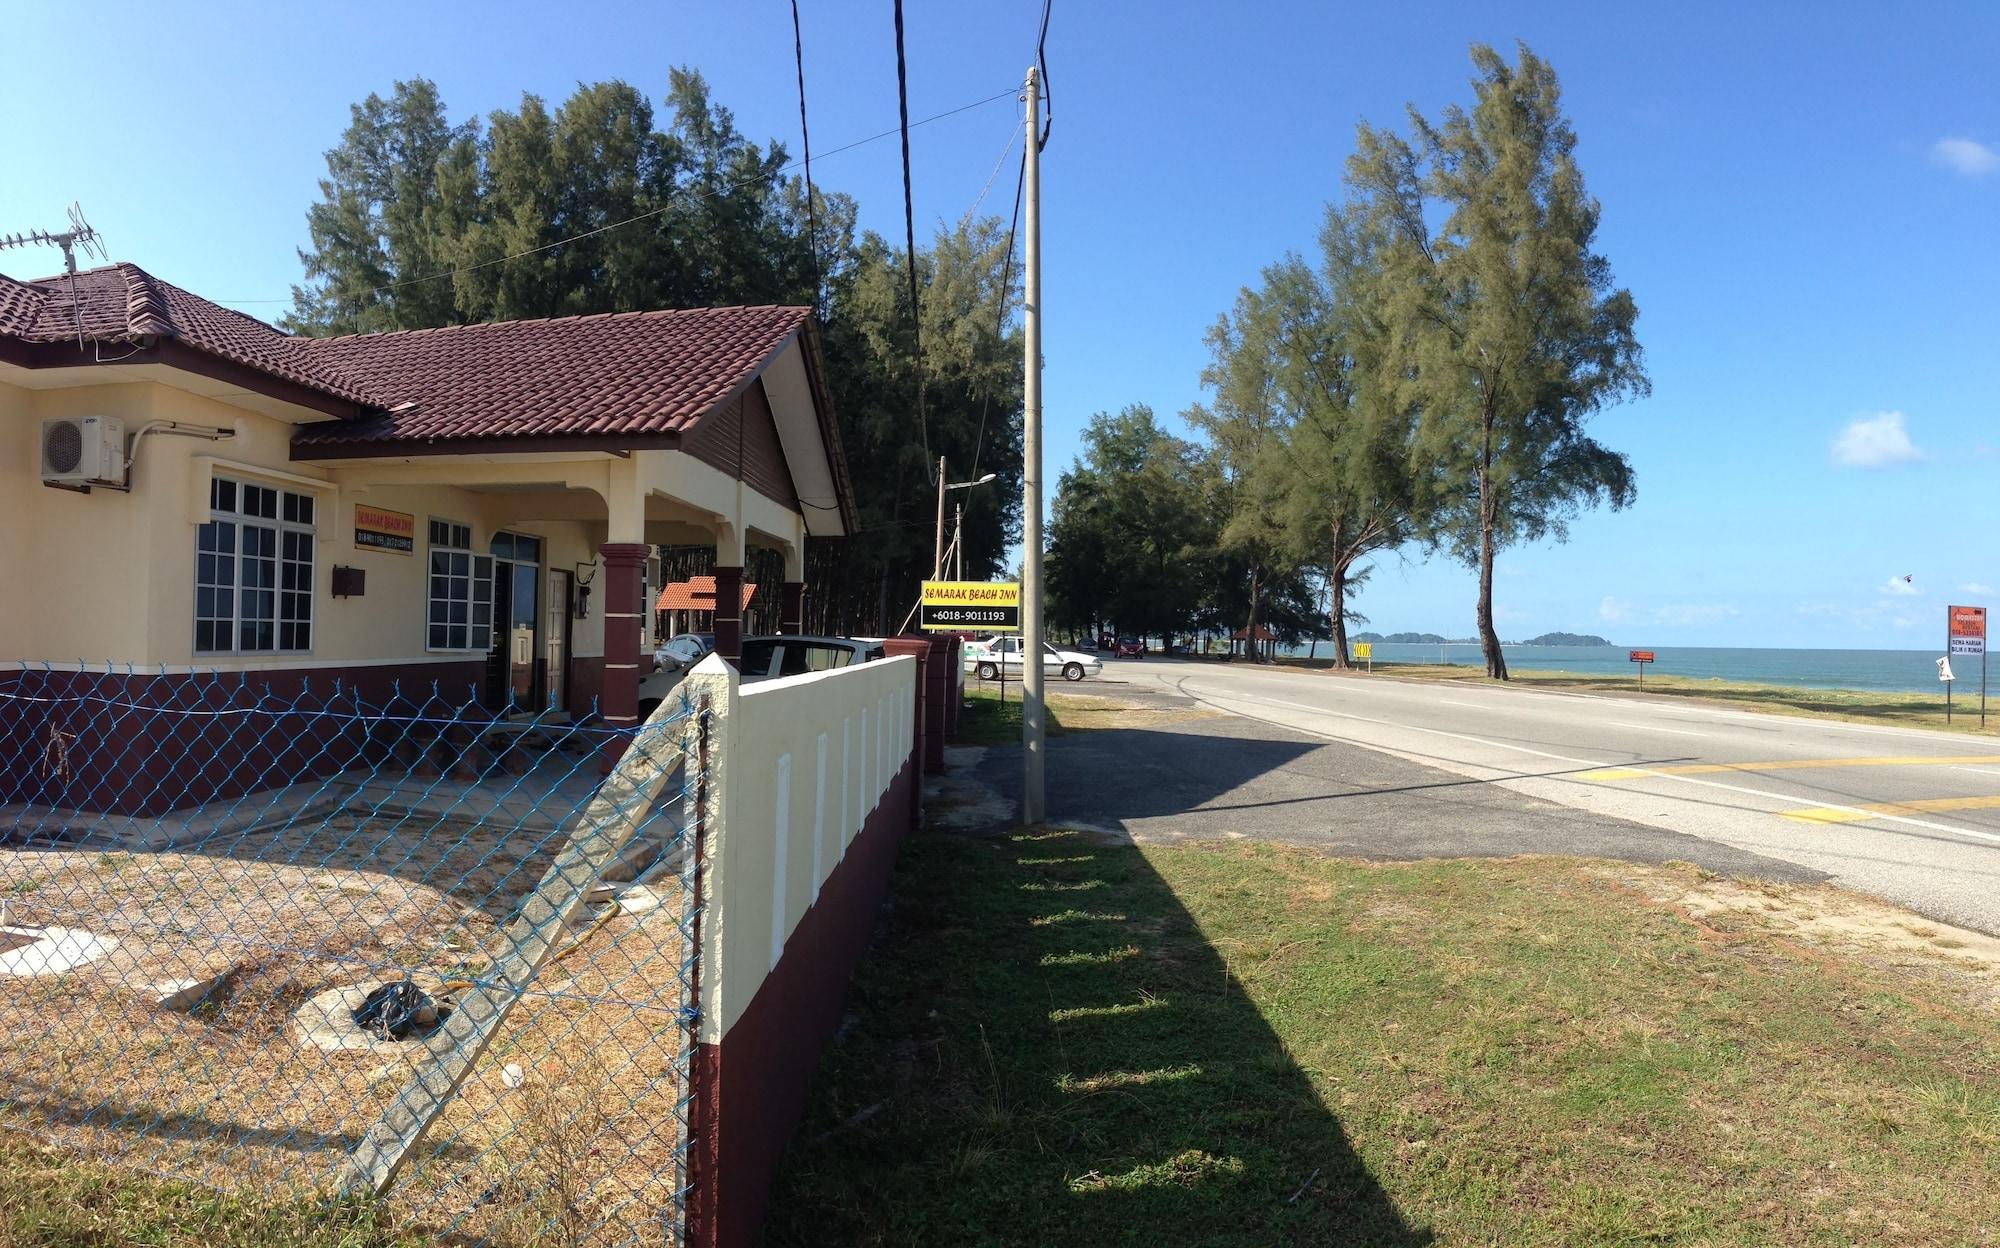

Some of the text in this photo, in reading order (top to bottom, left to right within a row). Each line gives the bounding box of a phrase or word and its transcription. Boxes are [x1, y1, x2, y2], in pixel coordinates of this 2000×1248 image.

[925, 588, 1017, 601] SEMARAK BEACH INN
[932, 610, 1005, 621] +6018-9011193
